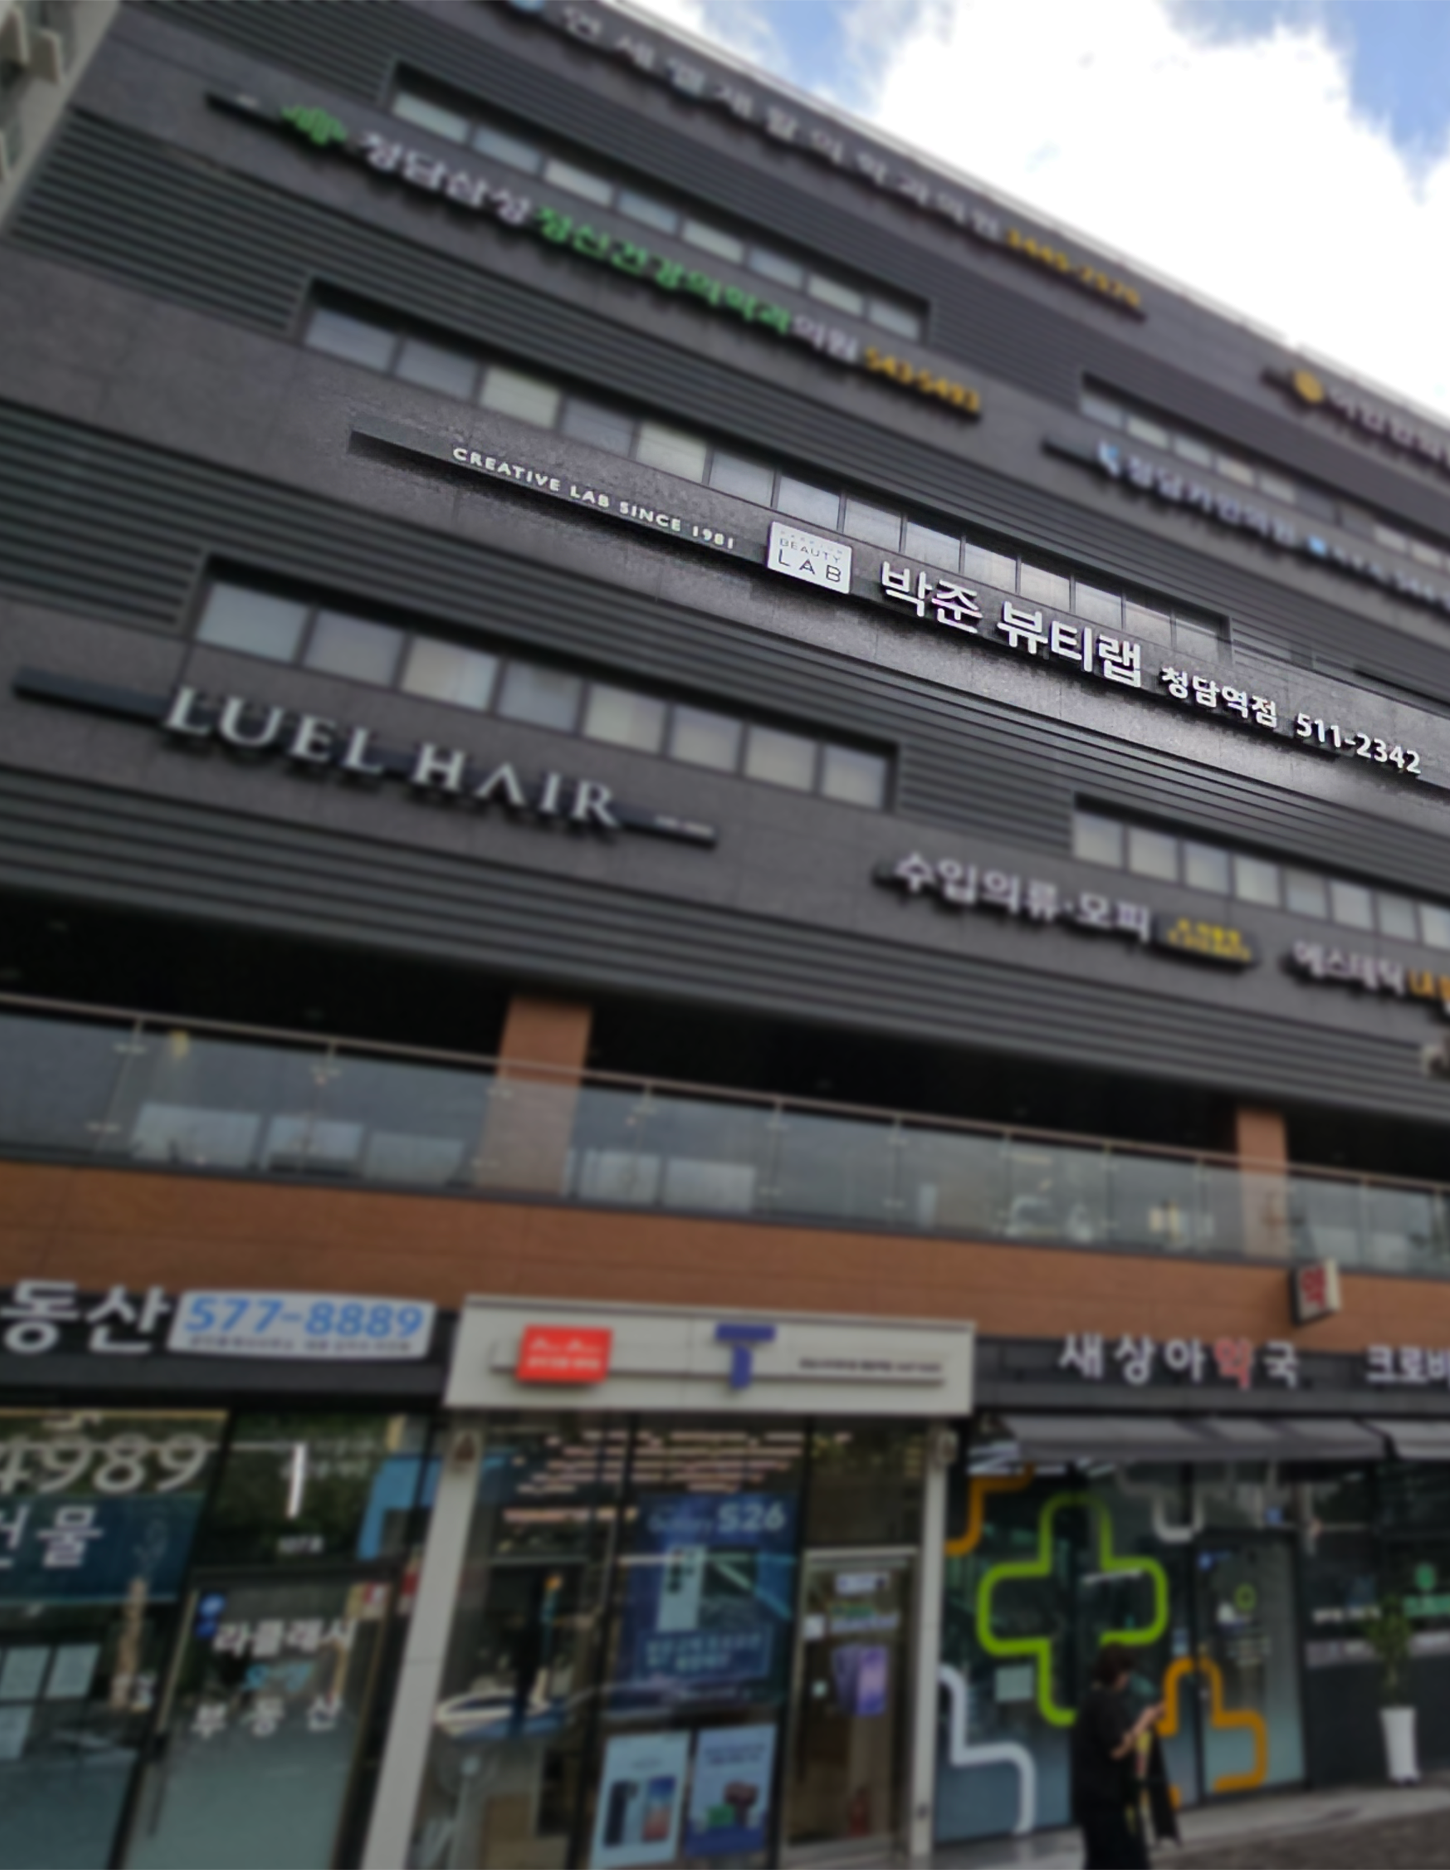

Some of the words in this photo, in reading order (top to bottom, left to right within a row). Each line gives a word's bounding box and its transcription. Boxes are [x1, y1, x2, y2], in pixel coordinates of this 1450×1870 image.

[453, 448, 560, 491] CREATIVE
[570, 485, 609, 507] LAB
[620, 501, 681, 532] SINCE
[693, 526, 734, 549] 1981
[778, 549, 841, 583] LAB
[780, 538, 841, 563] BEAUTY
[881, 561, 983, 634] 박준
[997, 600, 1141, 688] 뷰티랩
[1161, 666, 1278, 729] 청담역점
[1296, 713, 1421, 774] 511-2342
[162, 686, 385, 774] LUEL
[184, 1296, 424, 1339] 577-8889
[718, 1501, 785, 1535] S26
